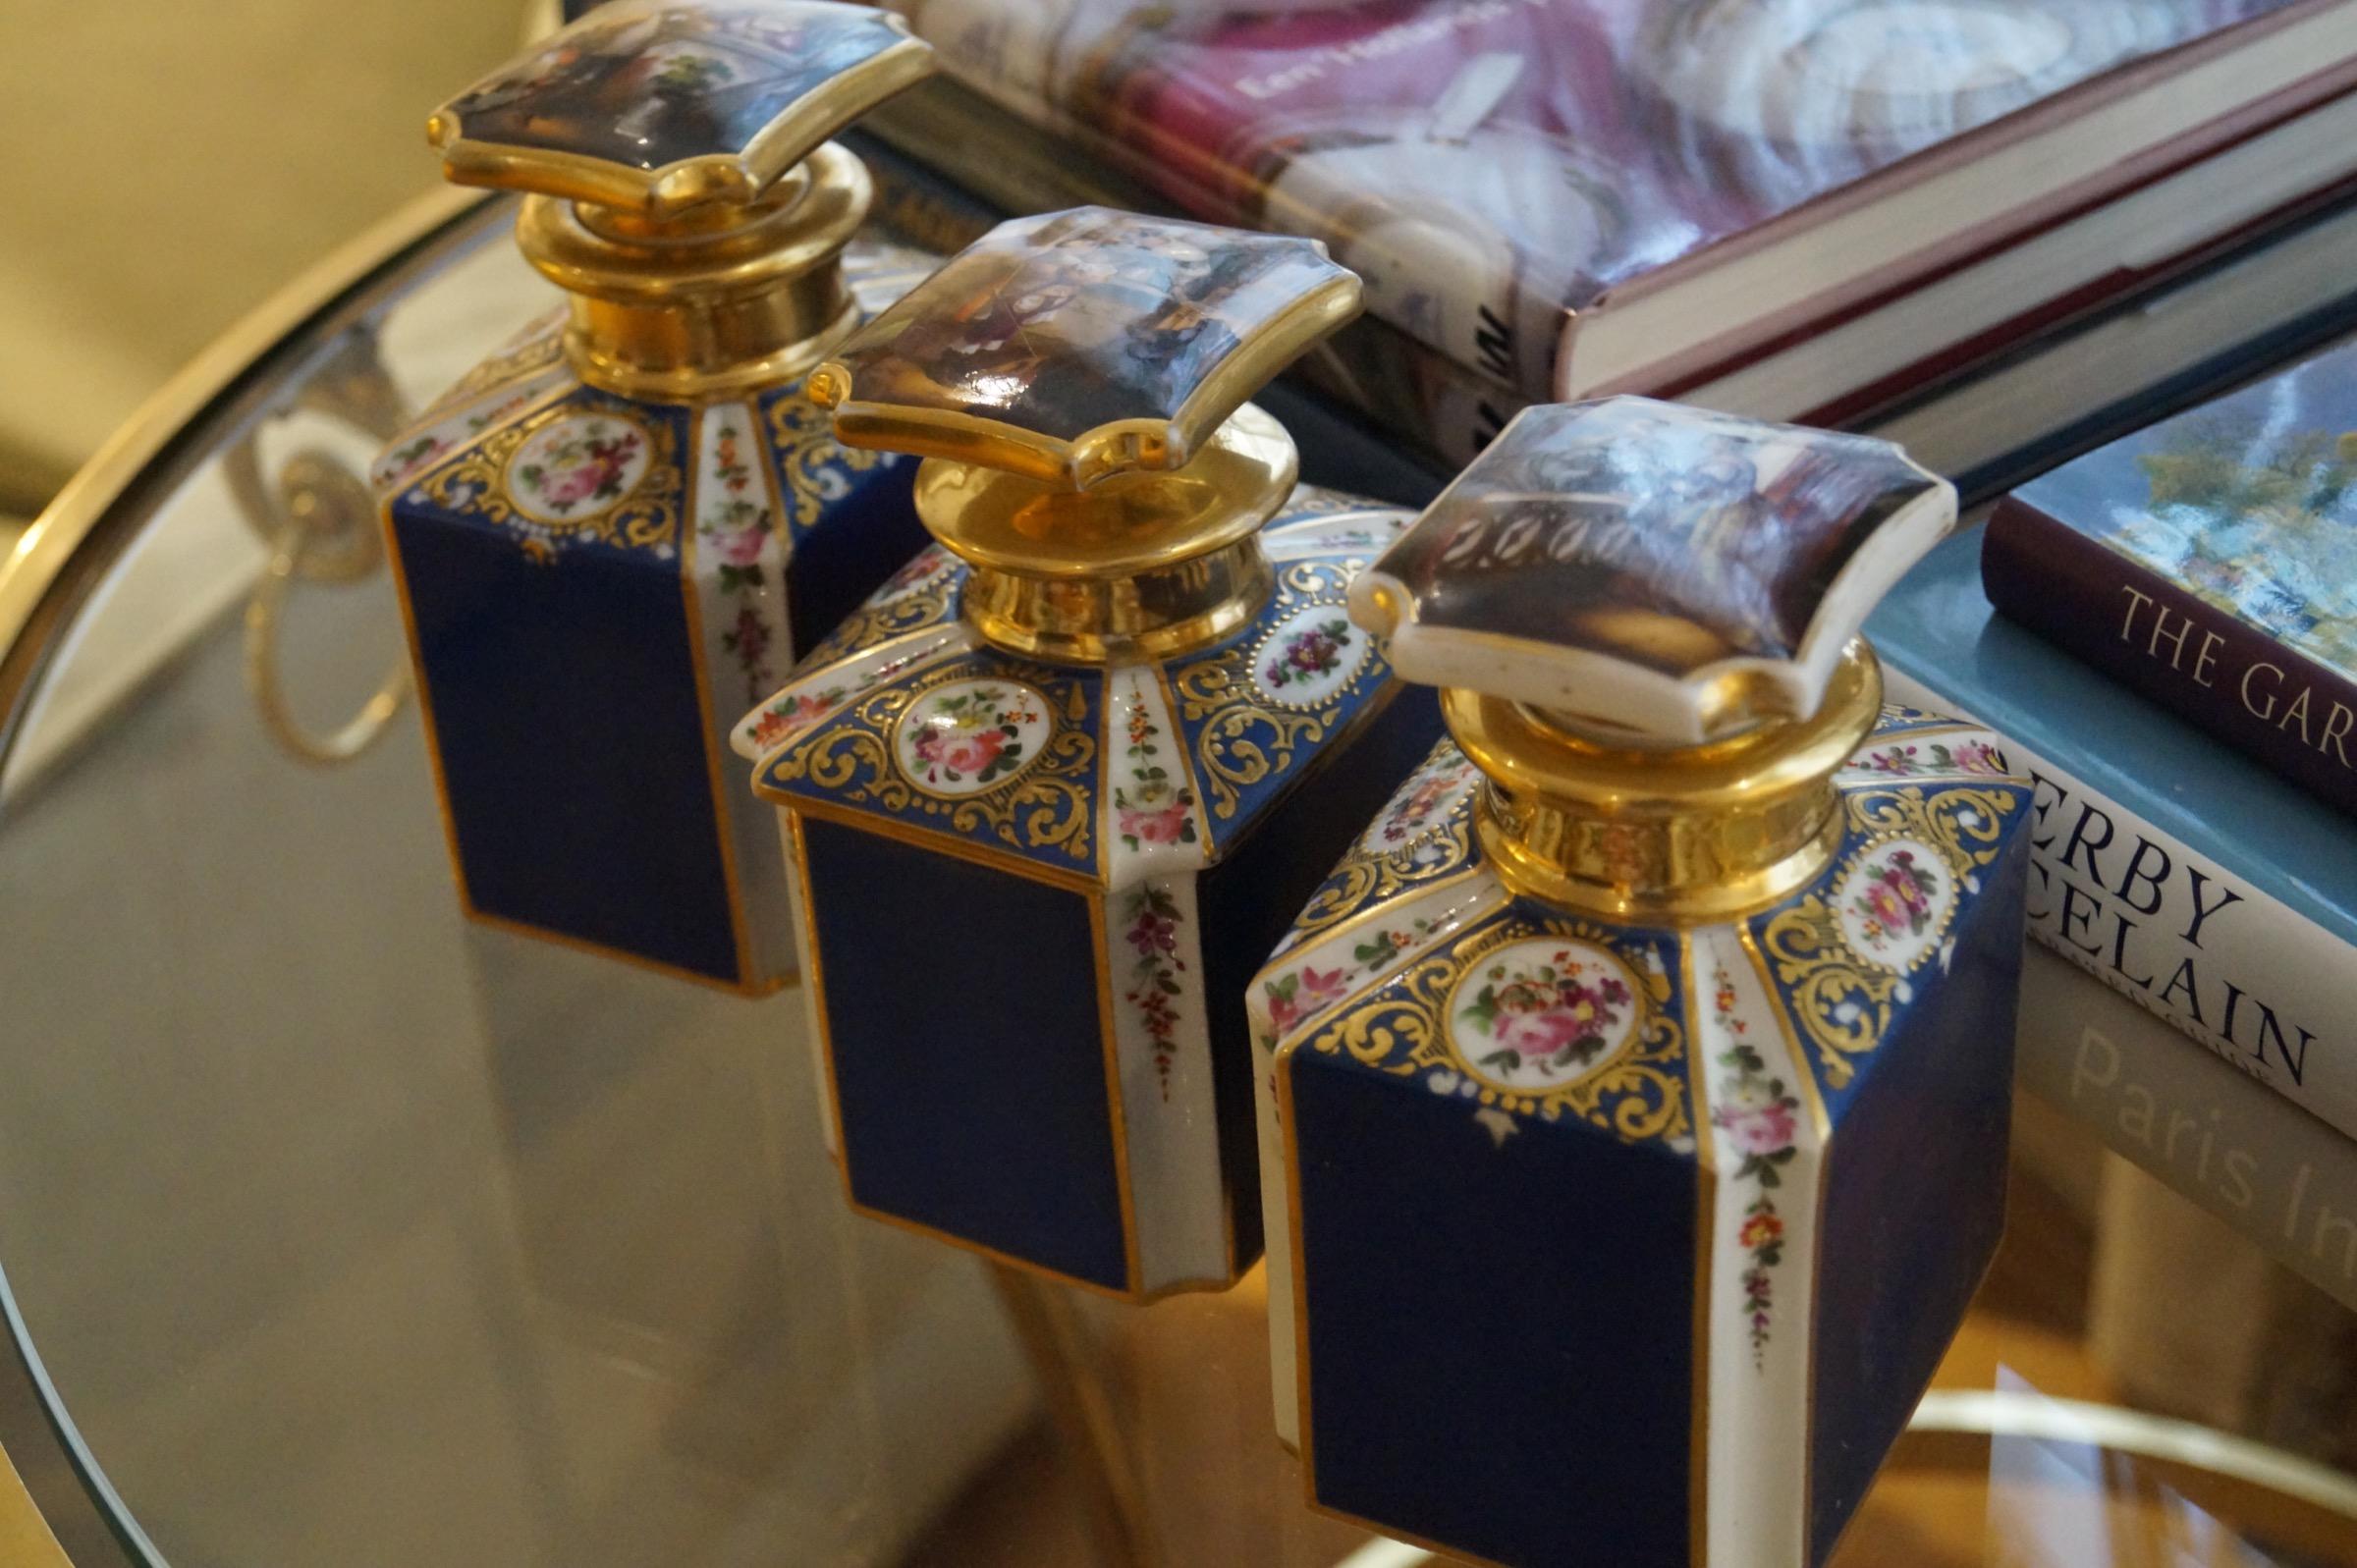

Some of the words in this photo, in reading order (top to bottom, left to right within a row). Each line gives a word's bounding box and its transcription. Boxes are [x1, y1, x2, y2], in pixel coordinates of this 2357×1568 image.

[2121, 585, 2225, 687] THE
[2241, 662, 2355, 769] GAR
[2071, 1024, 2258, 1209] Paris
